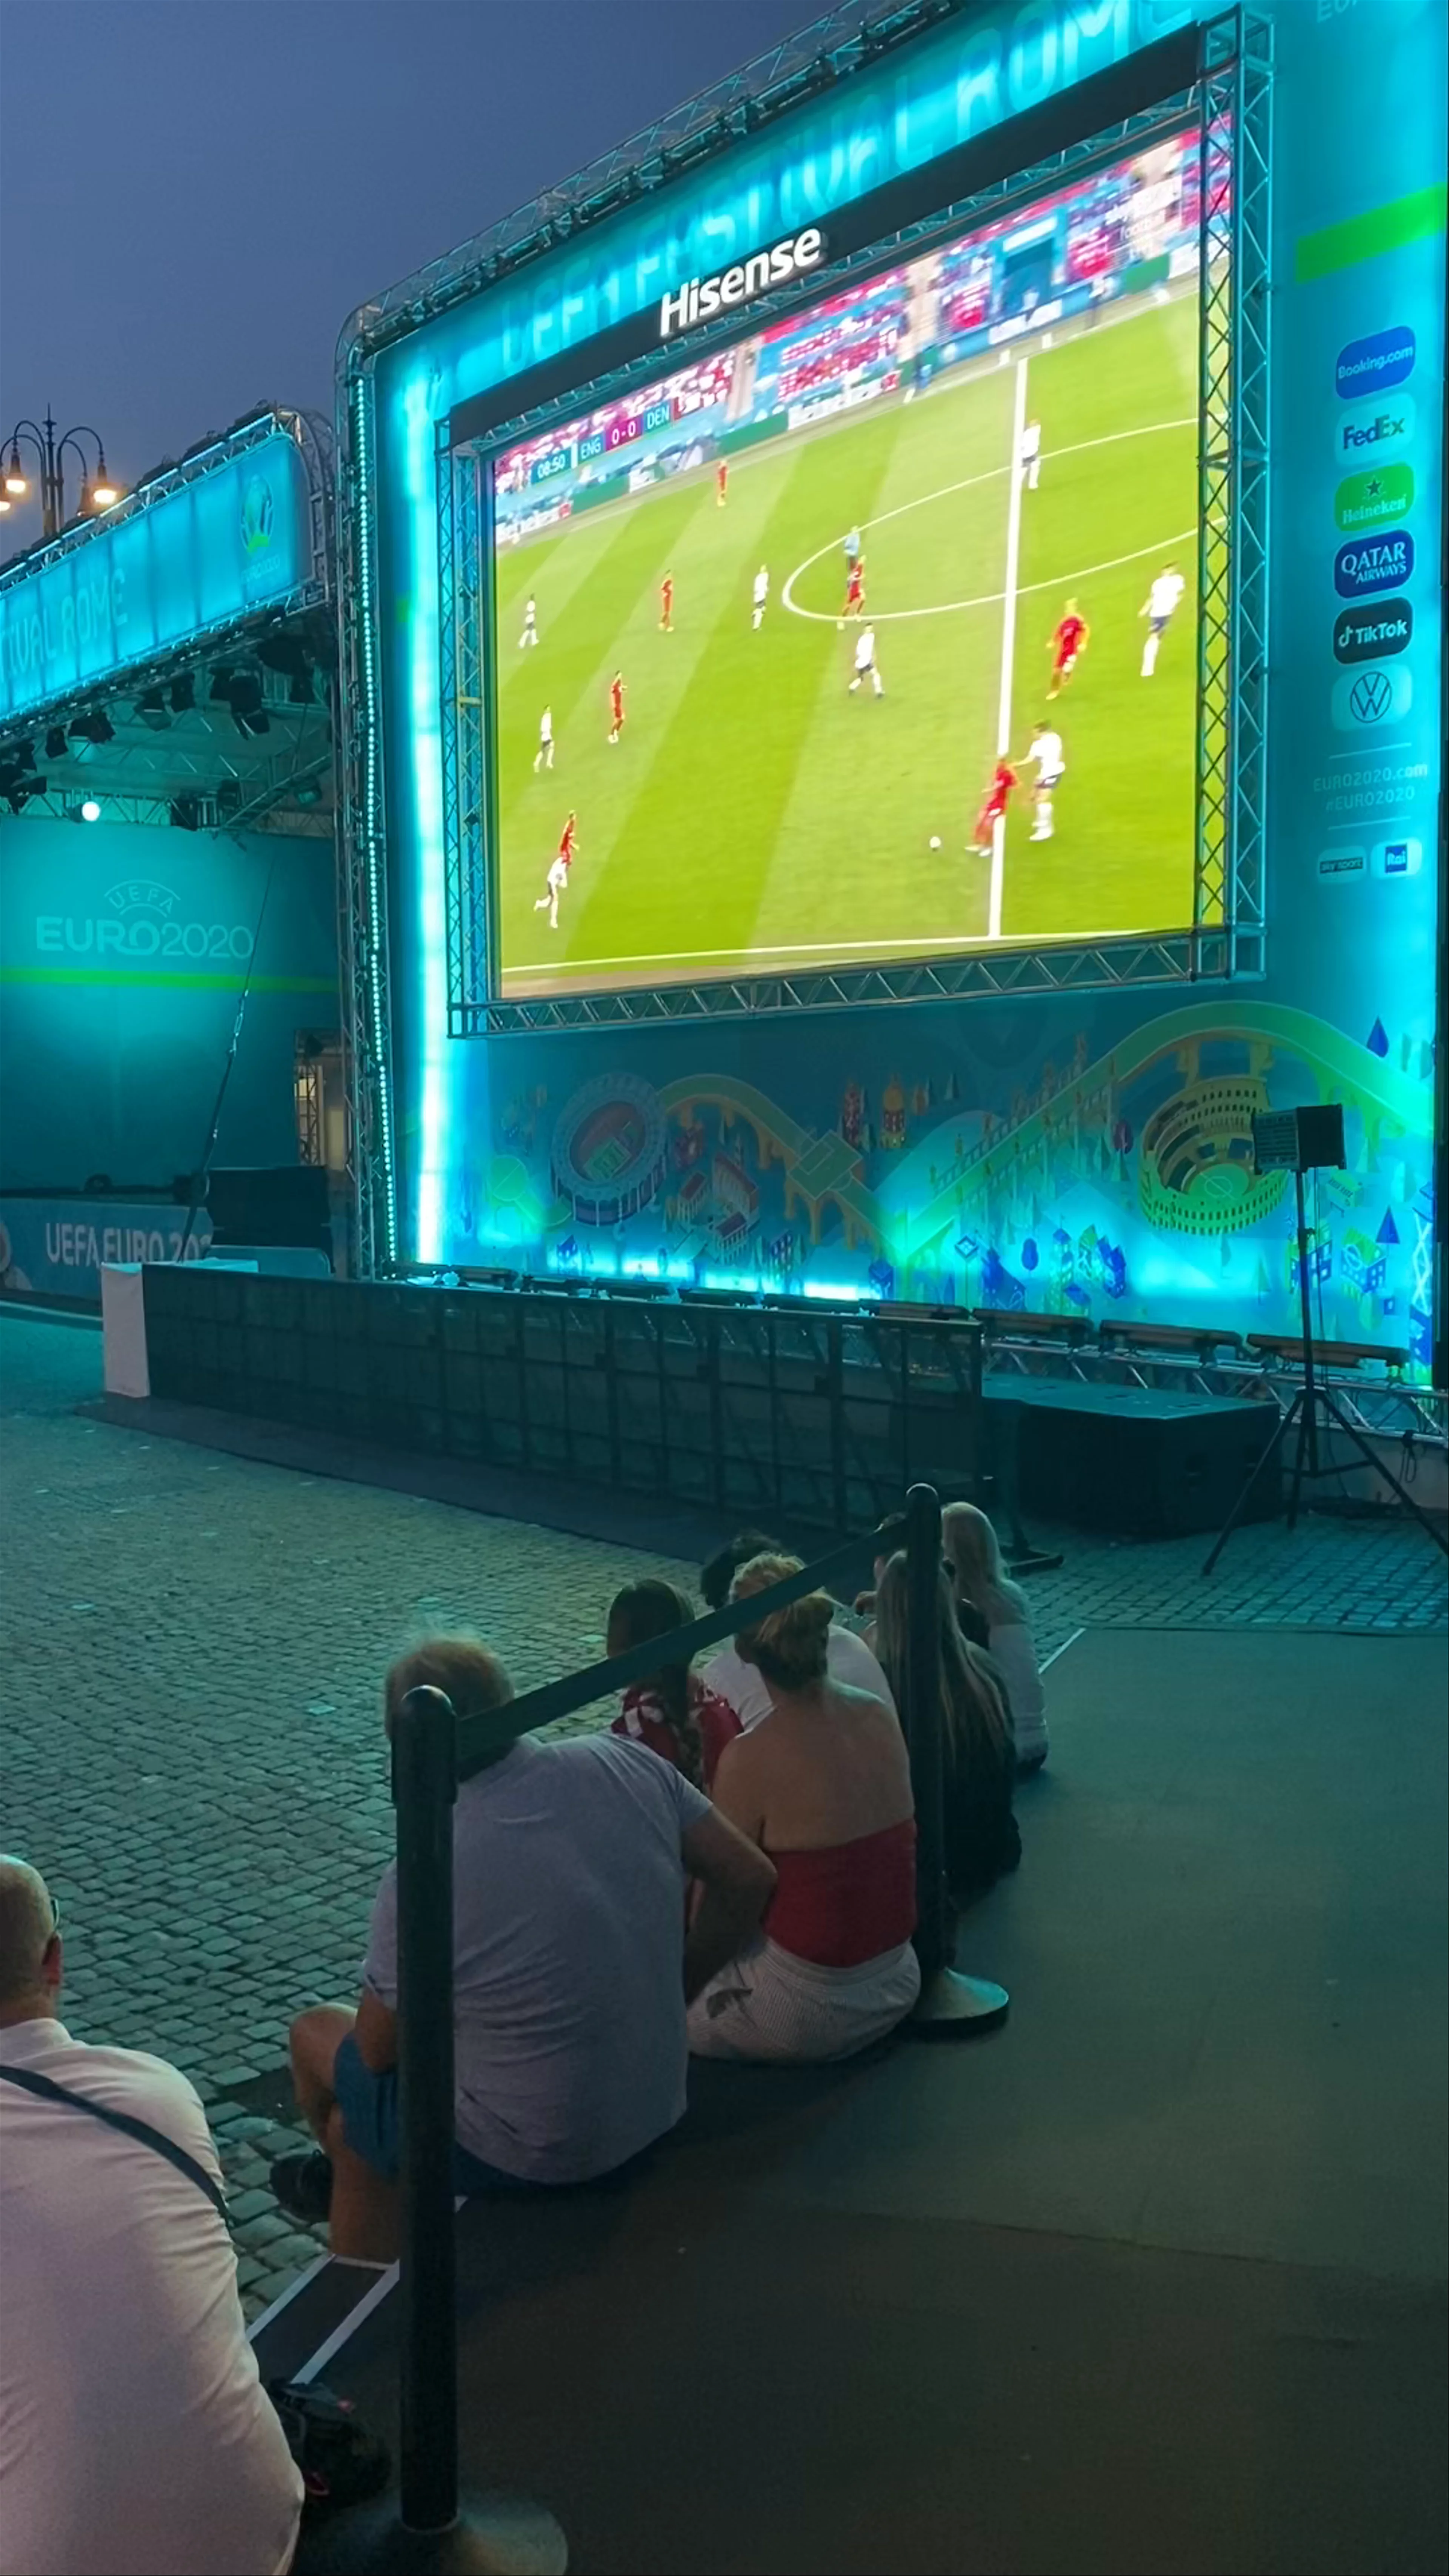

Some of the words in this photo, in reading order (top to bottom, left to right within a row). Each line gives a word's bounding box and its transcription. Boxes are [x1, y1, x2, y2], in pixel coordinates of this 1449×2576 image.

[660, 228, 822, 338] Hisense
[1338, 346, 1413, 379] Booking.com
[581, 438, 601, 458] ENG
[647, 404, 670, 429] DEN
[1343, 414, 1405, 449] FedEx
[1343, 494, 1406, 524] Heineken
[1341, 541, 1406, 575] QATAR
[1356, 561, 1406, 584] AIRWAYS
[62, 568, 128, 654] ROME
[1356, 620, 1408, 644] TikTok
[1314, 764, 1428, 792] EURO2020.com
[1326, 786, 1415, 811] #EURO2020
[109, 886, 173, 914] UEFA
[37, 917, 254, 959] EURO2020
[46, 1223, 99, 1269] UEFA
